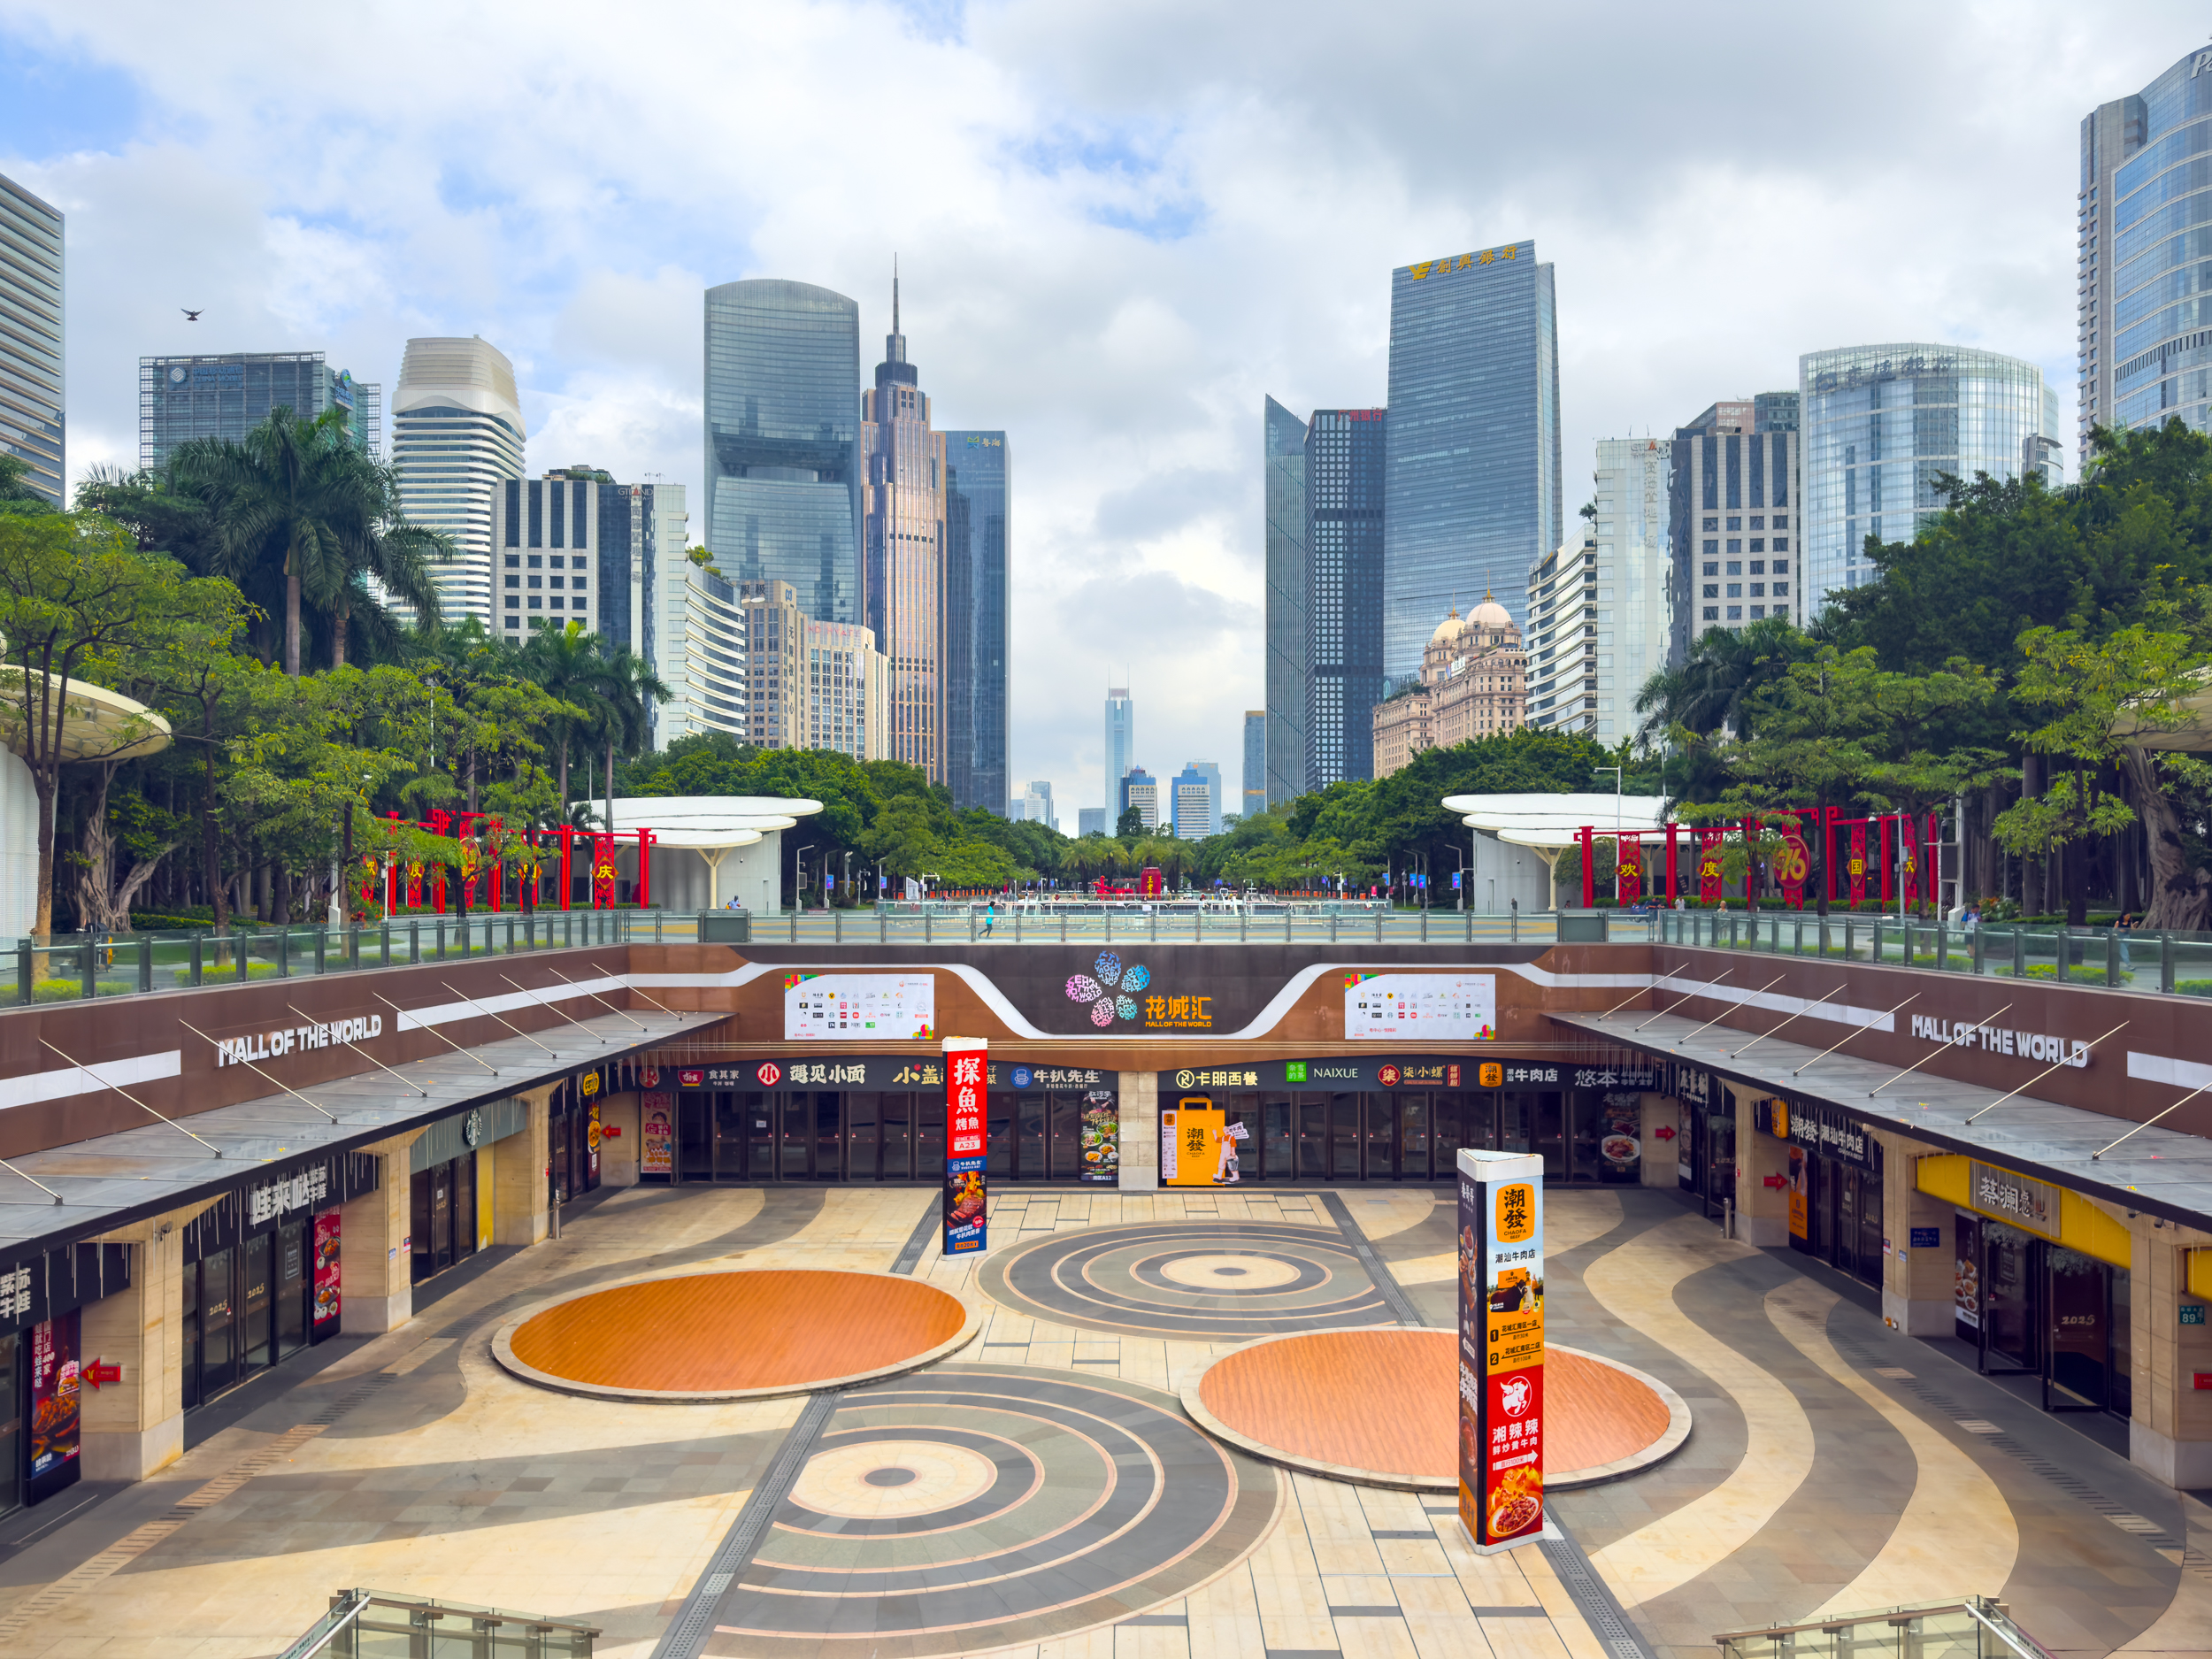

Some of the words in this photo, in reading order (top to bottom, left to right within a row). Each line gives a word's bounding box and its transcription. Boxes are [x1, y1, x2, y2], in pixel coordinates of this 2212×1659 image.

[1437, 245, 1517, 274] 創興銀行
[1337, 410, 1383, 422] 广州银行
[410, 859, 422, 879] 度
[596, 864, 614, 879] 庆
[1619, 863, 1639, 878] 欢
[1703, 861, 1721, 878] 度
[1778, 848, 1807, 881] 76
[1851, 858, 1863, 875] 国
[1145, 995, 1212, 1019] 花城汇
[217, 1033, 270, 1068] MALL
[270, 1029, 295, 1056] OF
[296, 1023, 329, 1051] THE
[330, 1014, 382, 1046] WORLD
[1911, 1014, 1953, 1043] MALL
[1953, 1022, 1977, 1048] OF
[1978, 1025, 2014, 1056] THE
[2016, 1031, 2091, 1069] WORLD
[709, 1069, 740, 1080] 食其家
[761, 1066, 777, 1082] 小
[789, 1064, 865, 1085] 遇见小面
[893, 1064, 943, 1085] 小盖
[1033, 1069, 1101, 1084] 牛扒先生
[1196, 1071, 1258, 1087] 卡朋西餐
[1314, 1068, 1358, 1079] NAIXUE
[1382, 1068, 1397, 1082] 柒
[1515, 1068, 1558, 1082] 牛肉店
[1575, 1069, 1618, 1087] 悠本
[954, 1057, 981, 1115] 探魚
[956, 1117, 979, 1132] 烤魚
[1790, 1115, 1819, 1143] 潮發
[1186, 1127, 1206, 1152] 潮發
[1821, 1124, 1863, 1155] 潮汕牛肉店
[249, 1173, 310, 1226] 蛙来哒
[1979, 1176, 2019, 1213] 蔡澜
[1503, 1188, 1528, 1229] 潮發
[1494, 1248, 1536, 1264] 潮汕牛肉店
[0, 1267, 31, 1297] 紫苏
[247, 1283, 265, 1300] 2025
[0, 1290, 31, 1318] 牛蛙
[209, 1299, 227, 1317] 2025
[1502, 1319, 1538, 1333] 花城汇南区一店
[2061, 1315, 2096, 1326] 2025
[2182, 1313, 2196, 1323] 89
[1505, 1341, 1541, 1356] 花城汇南区二店
[1493, 1418, 1539, 1444] 湘辣辣
[1493, 1436, 1538, 1455] 鲜炒黄牛肉
